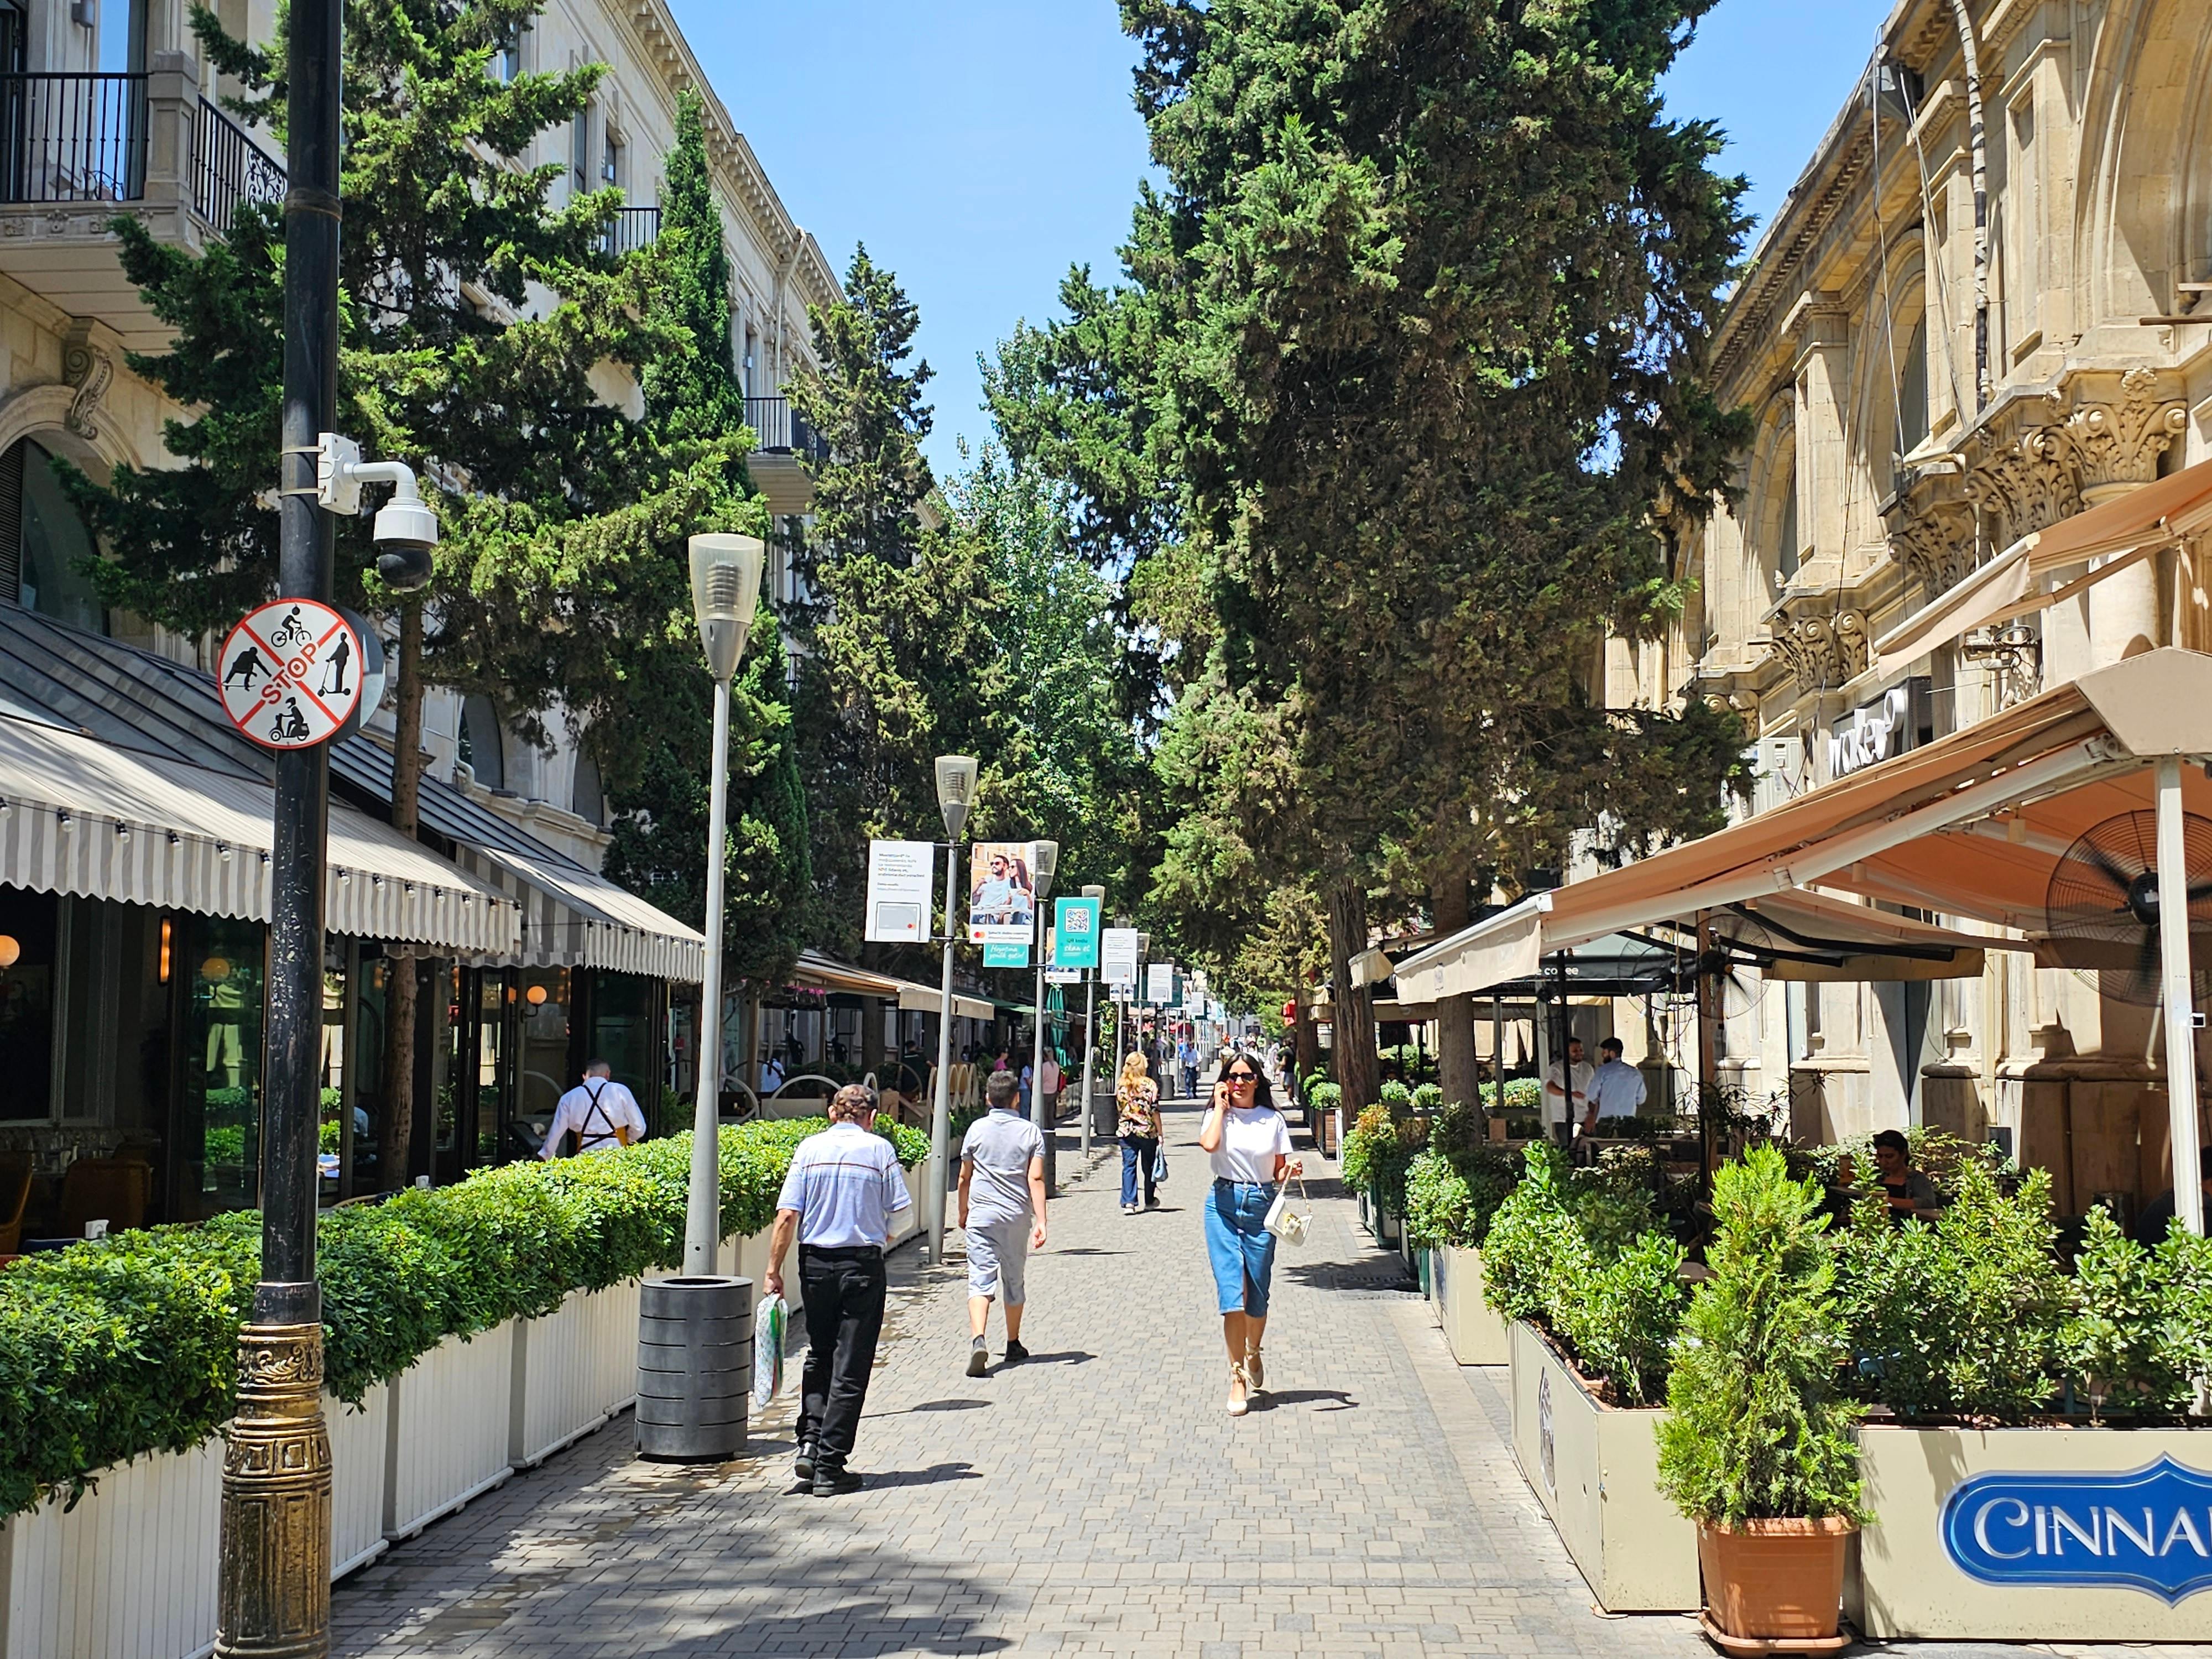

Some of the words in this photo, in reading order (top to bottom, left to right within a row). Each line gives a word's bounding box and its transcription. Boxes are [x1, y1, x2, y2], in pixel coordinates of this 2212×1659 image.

[261, 643, 319, 705] STOP
[1544, 967, 1579, 975] coee
[1974, 1496, 2212, 1559] CINNA
